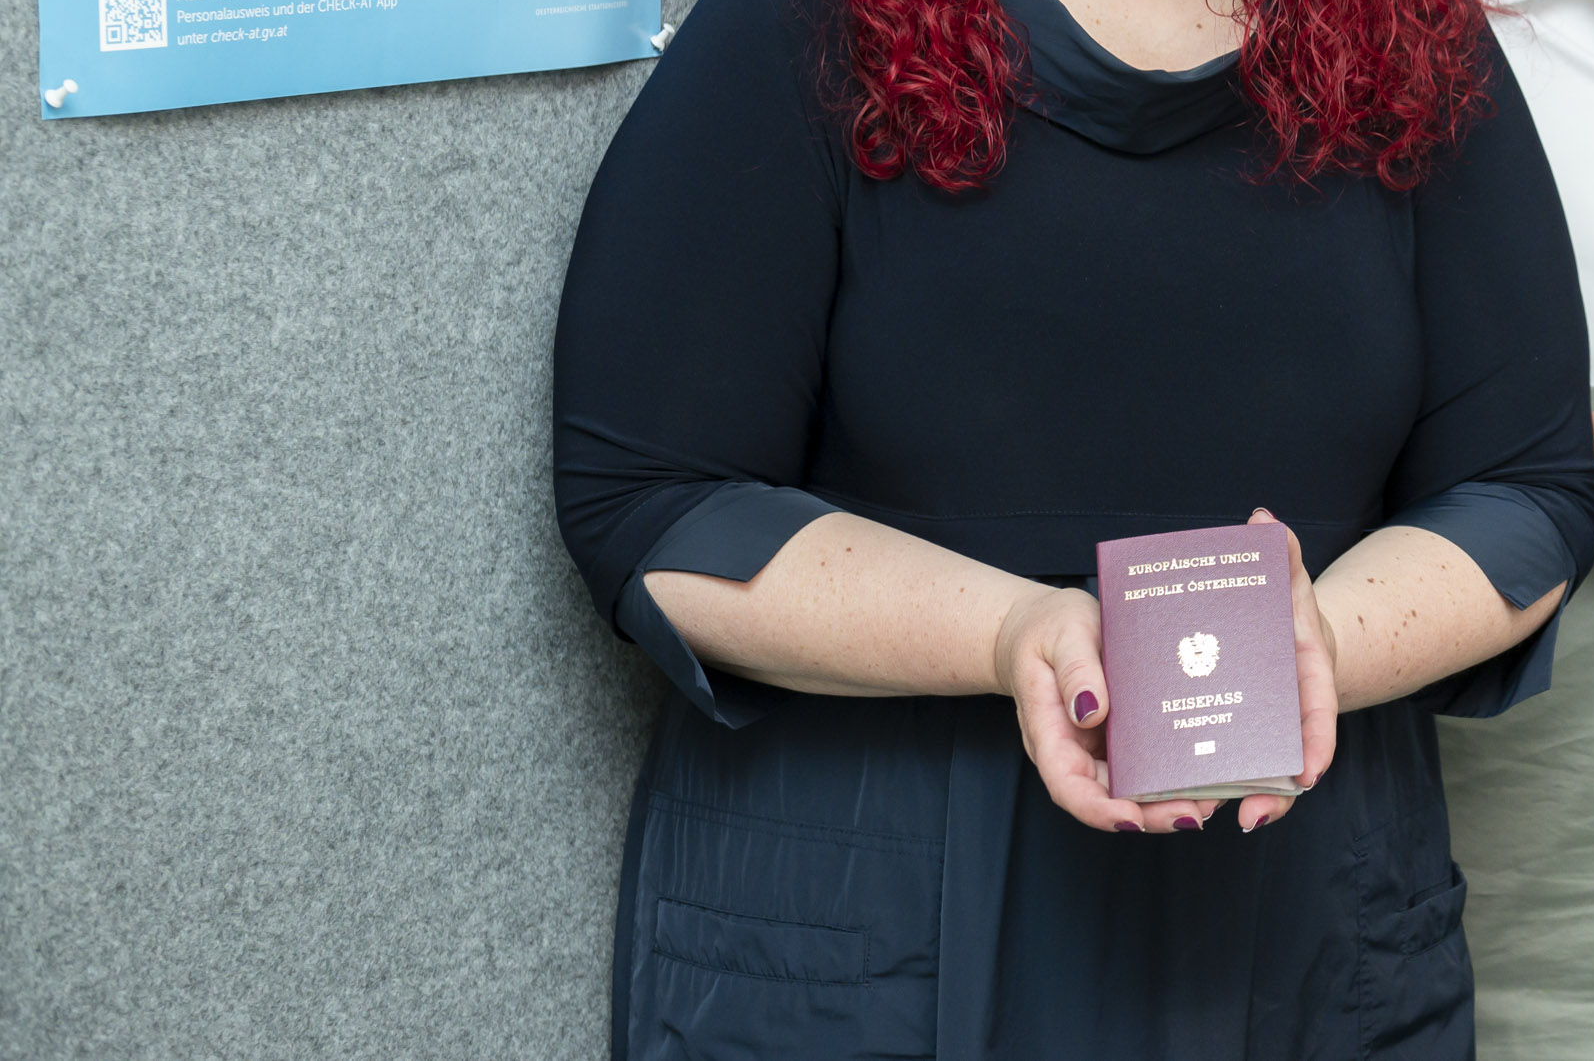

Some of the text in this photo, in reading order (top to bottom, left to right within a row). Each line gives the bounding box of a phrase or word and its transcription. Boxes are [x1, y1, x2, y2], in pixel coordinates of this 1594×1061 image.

[177, 5, 270, 23] Personalausweis
[273, 3, 294, 16] und
[297, 2, 315, 14] der
[177, 25, 288, 45] unter check-at.gv.at
[1128, 551, 1261, 576] EUROPÄISCHE UNION
[1124, 575, 1267, 601] REPUBLIK ÖSTERREICH
[1161, 691, 1243, 713] REISEPASS
[1173, 712, 1233, 729] PASSPORT
